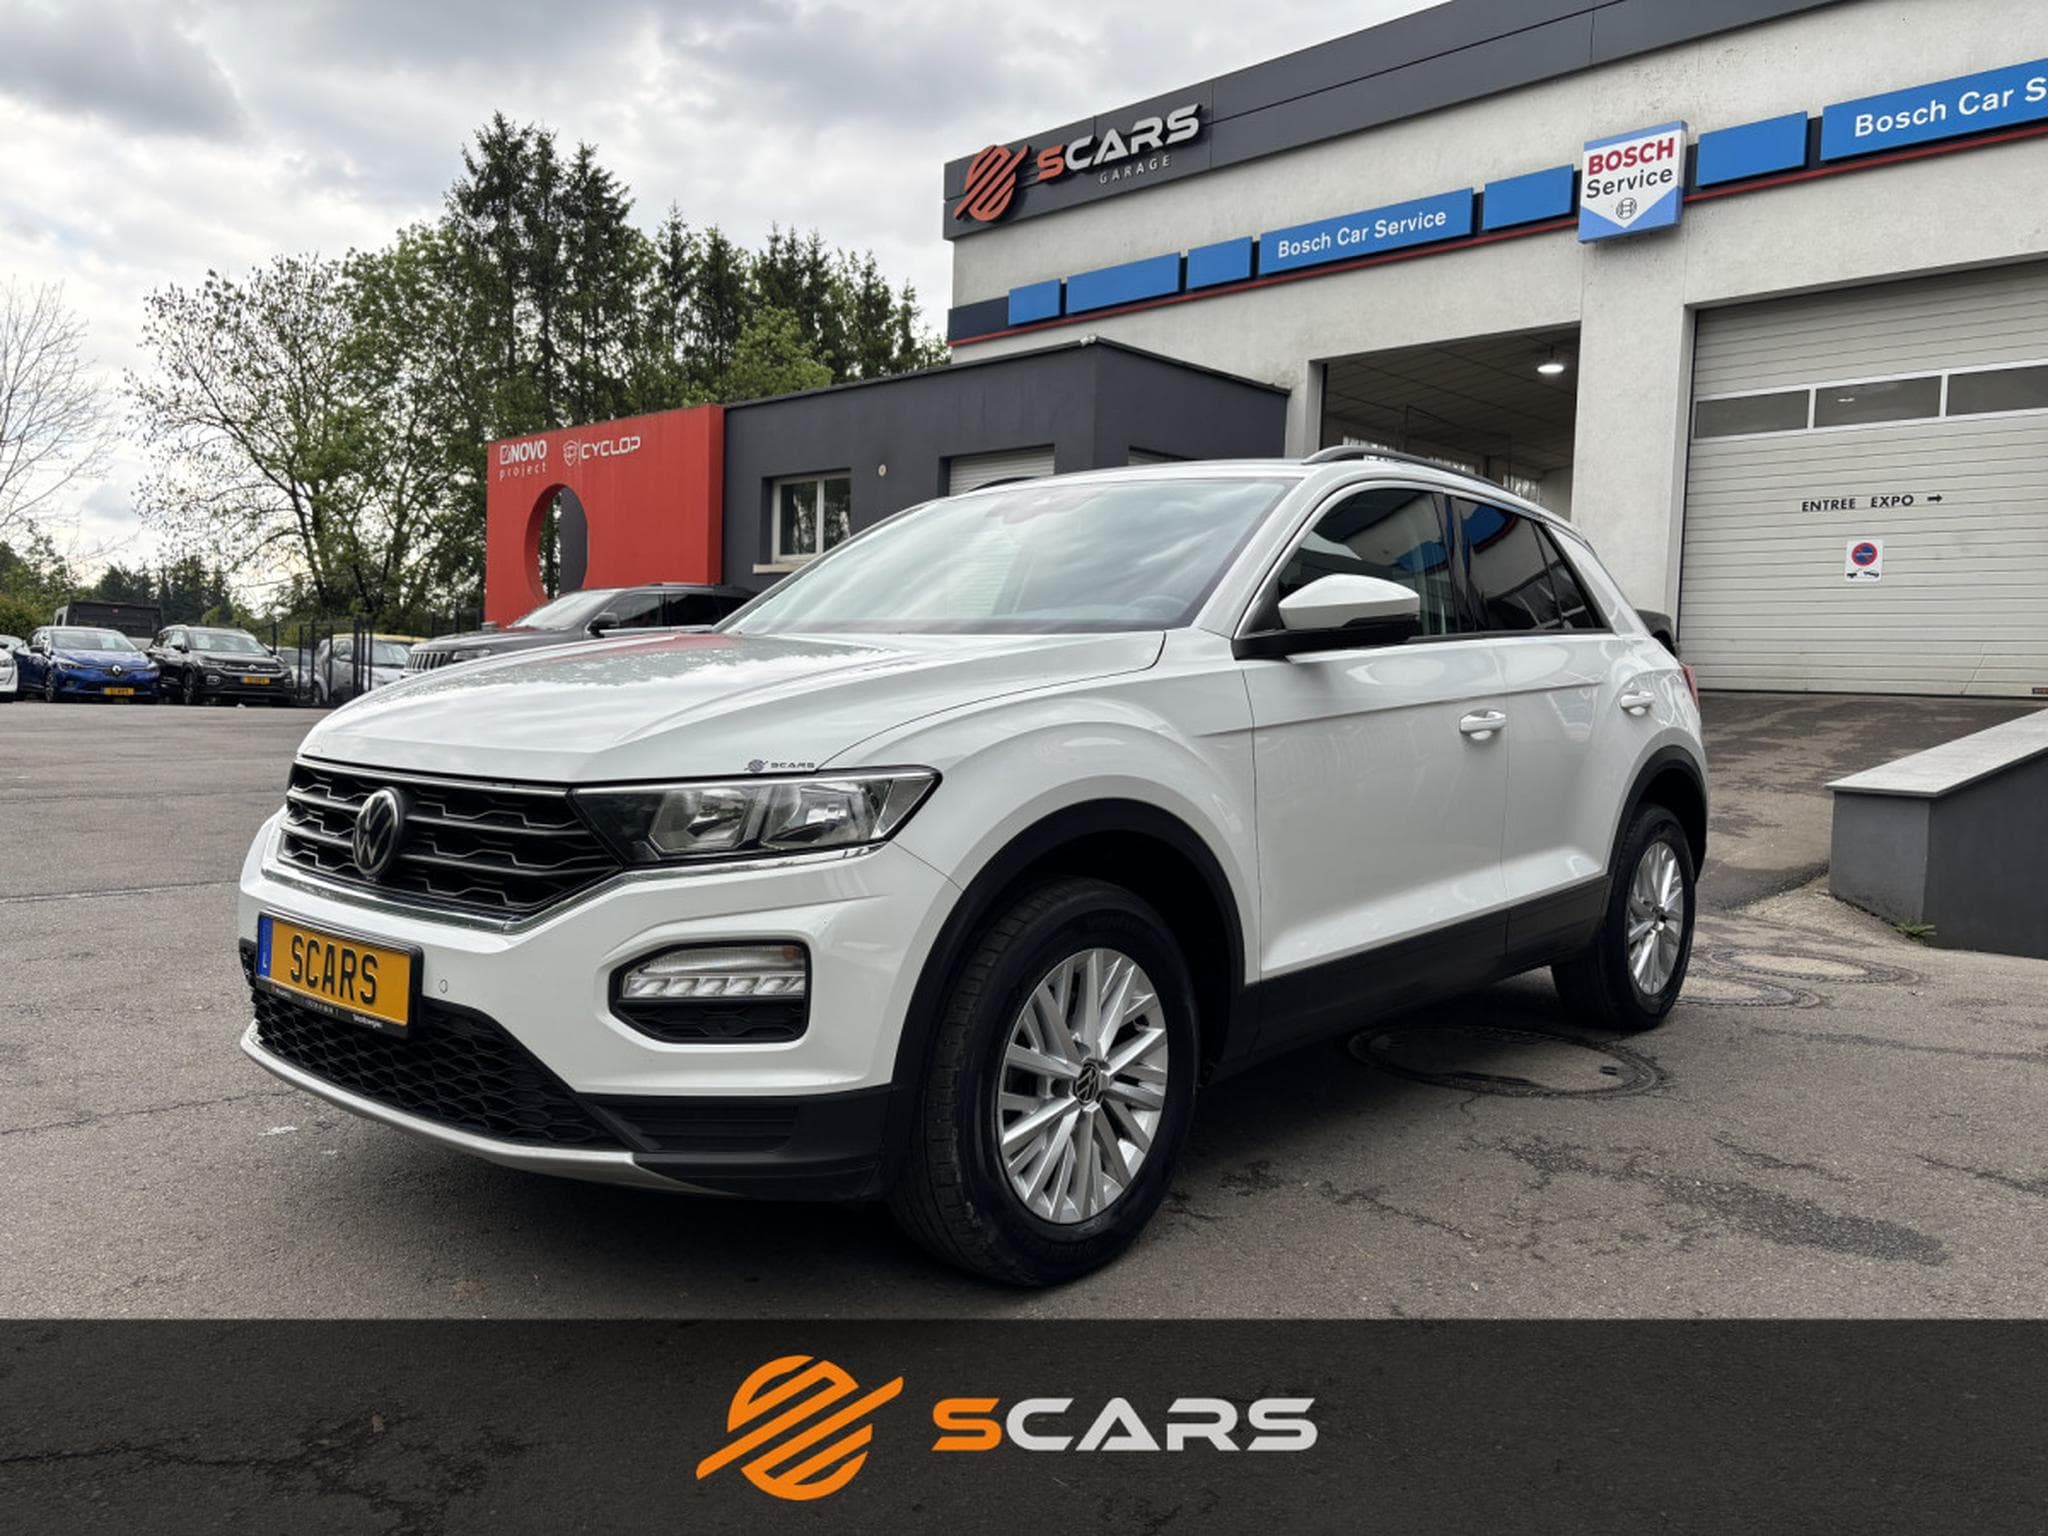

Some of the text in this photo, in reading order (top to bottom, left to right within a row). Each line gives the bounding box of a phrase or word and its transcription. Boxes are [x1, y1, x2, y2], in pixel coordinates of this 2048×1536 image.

[1855, 99, 1947, 137] Bosch
[1958, 89, 2015, 115] Car
[1036, 103, 1200, 181] SCARS
[1588, 137, 1674, 176] BOSCH
[1100, 154, 1171, 184] GARAGE
[1586, 168, 1673, 199] Service
[1277, 210, 1447, 258] Bosch Car Service
[581, 436, 641, 459] CYCLOP
[499, 461, 547, 481] project
[1801, 494, 1914, 512] ENTREE EXPO
[290, 934, 378, 1005] SCARS
